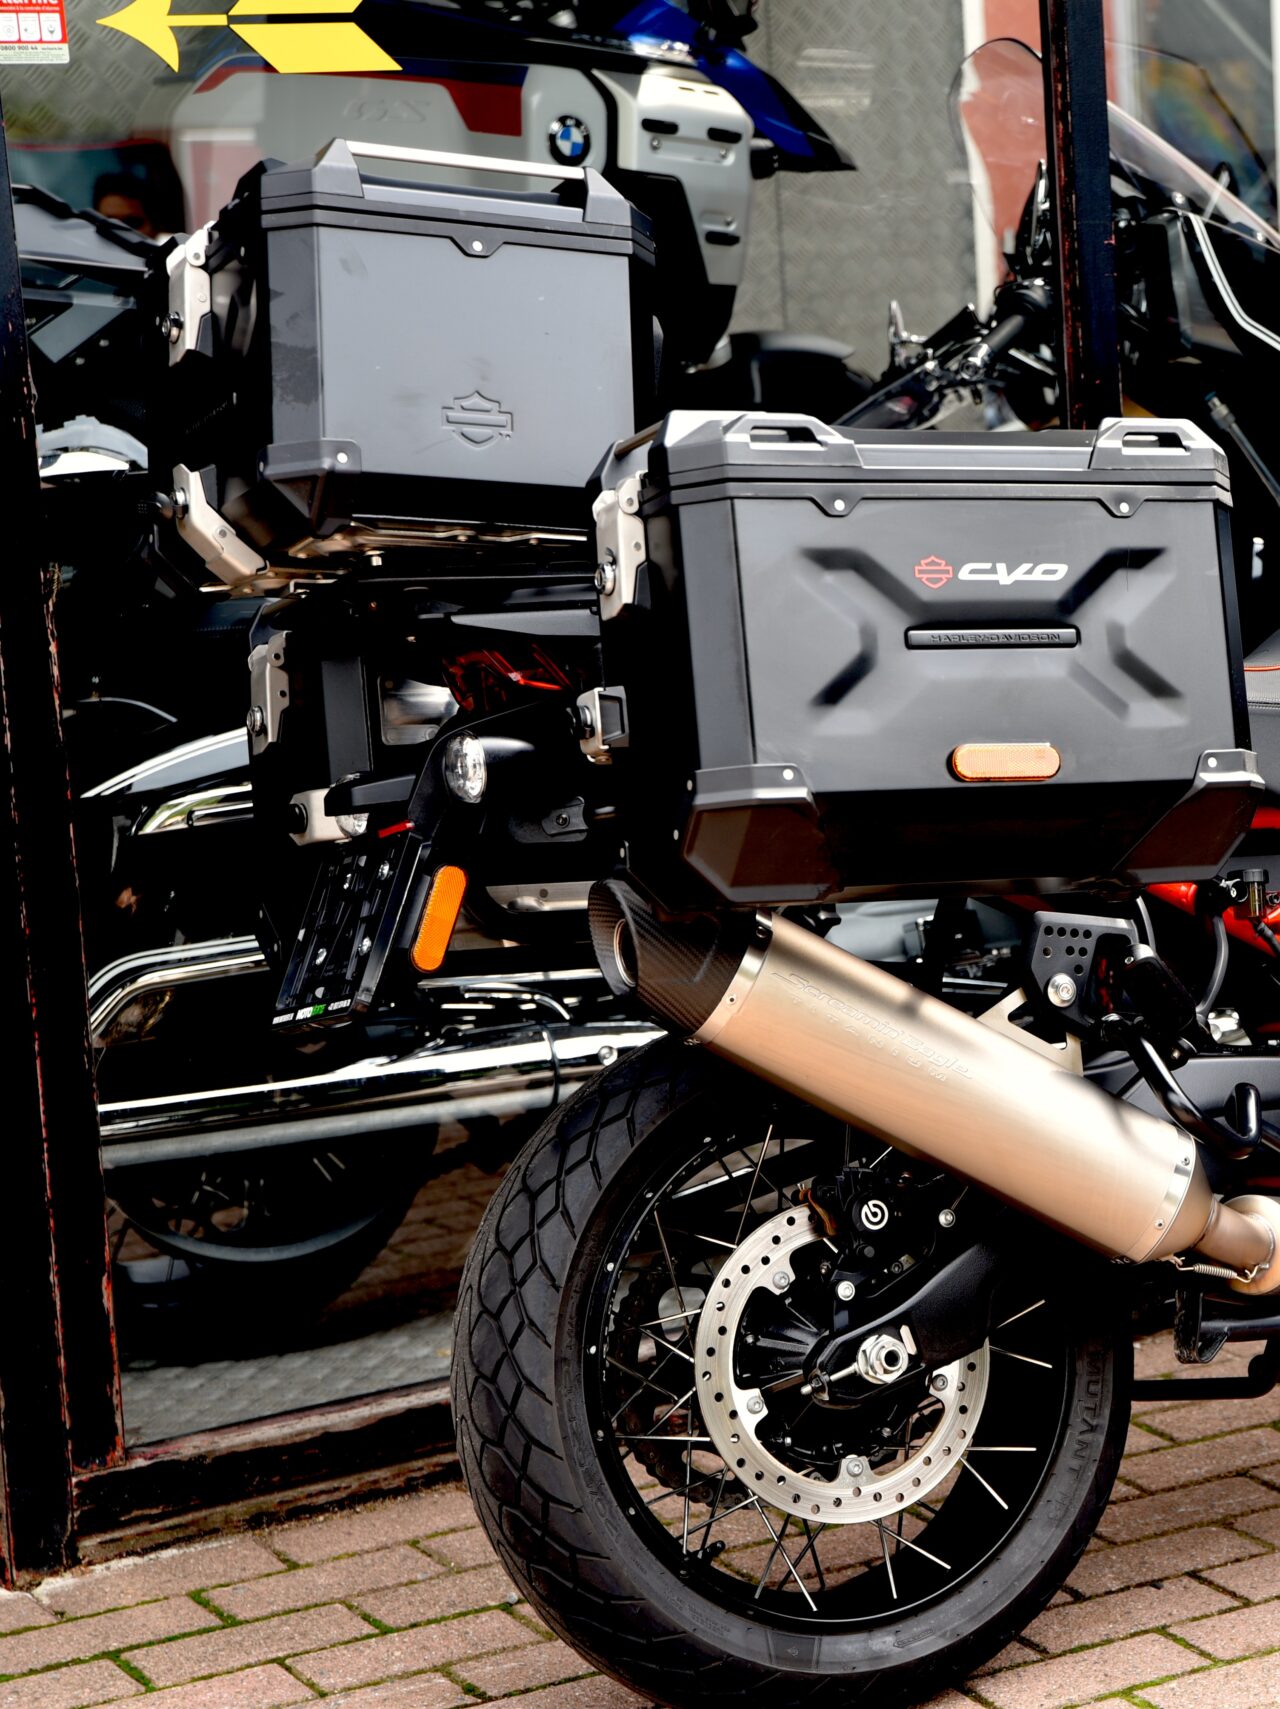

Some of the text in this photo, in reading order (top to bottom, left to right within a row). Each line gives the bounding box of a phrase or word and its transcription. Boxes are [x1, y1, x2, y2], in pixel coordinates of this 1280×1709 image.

[957, 562, 1069, 585] CVO
[930, 633, 1061, 643] HARLEY-DAVIDSON
[772, 972, 973, 1080] Screamin' Eagle
[792, 996, 948, 1082] TITANIUM
[1068, 1348, 1101, 1481] MUTANT
